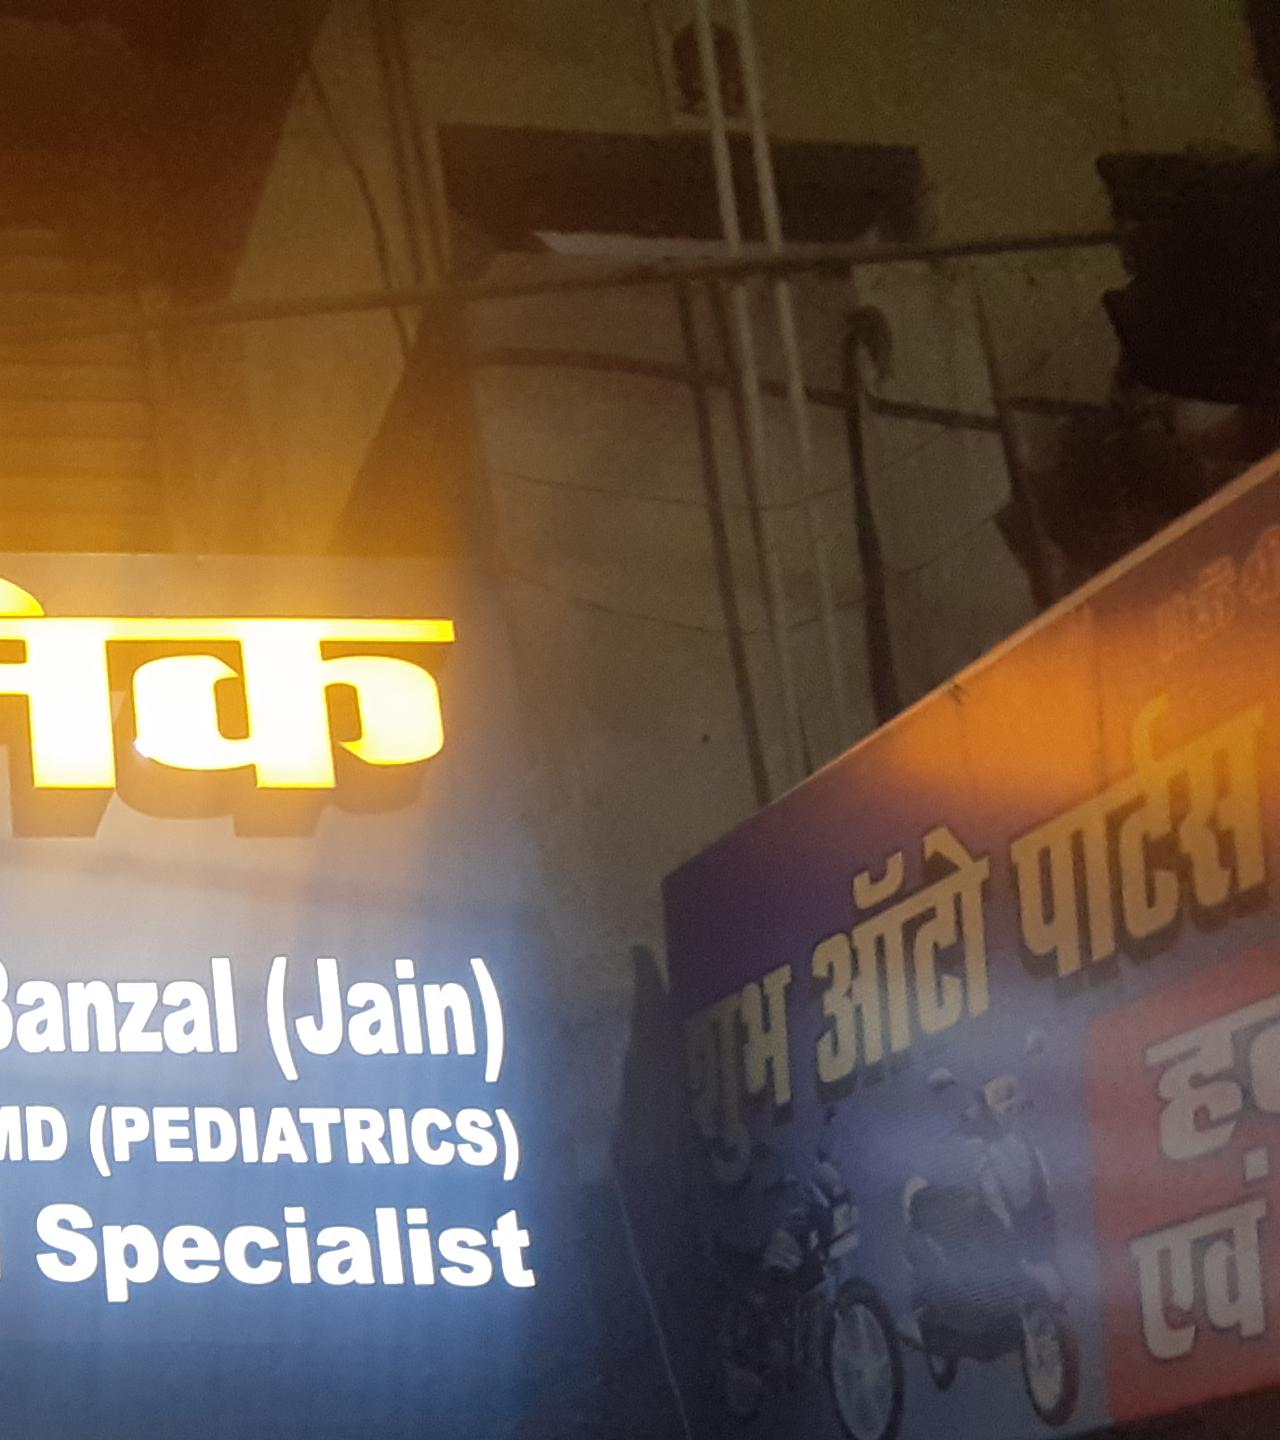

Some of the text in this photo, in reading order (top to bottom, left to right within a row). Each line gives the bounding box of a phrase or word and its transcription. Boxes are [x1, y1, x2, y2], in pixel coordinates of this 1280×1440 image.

[810, 827, 991, 1084] ऑटो
[265, 956, 505, 1084] (Jain)
[88, 1104, 520, 1182] (PEDIATRICS)
[35, 1203, 537, 1304] Specialist
[1129, 1146, 1268, 1362] एवं
